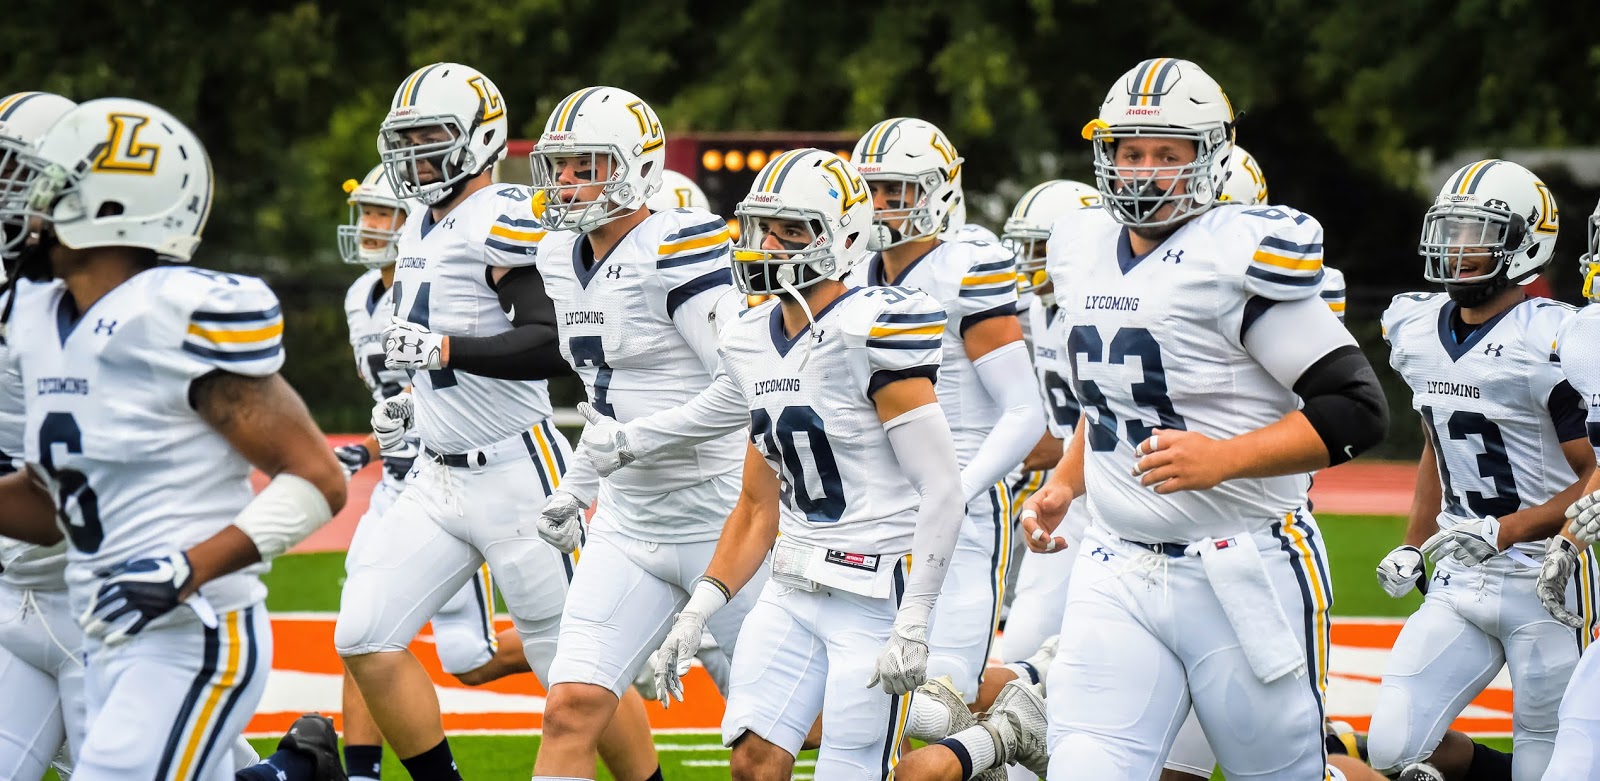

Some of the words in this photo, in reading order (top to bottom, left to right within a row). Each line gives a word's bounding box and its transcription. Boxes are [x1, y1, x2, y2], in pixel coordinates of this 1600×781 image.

[92, 112, 161, 176] L
[821, 157, 869, 214] L
[565, 311, 605, 326] LYCOMING
[1085, 295, 1140, 311] LYCOMING
[754, 378, 801, 396] LYCOMING
[1067, 324, 1188, 452] 63
[1427, 381, 1481, 400] LYCOMING
[1421, 404, 1522, 520] 13
